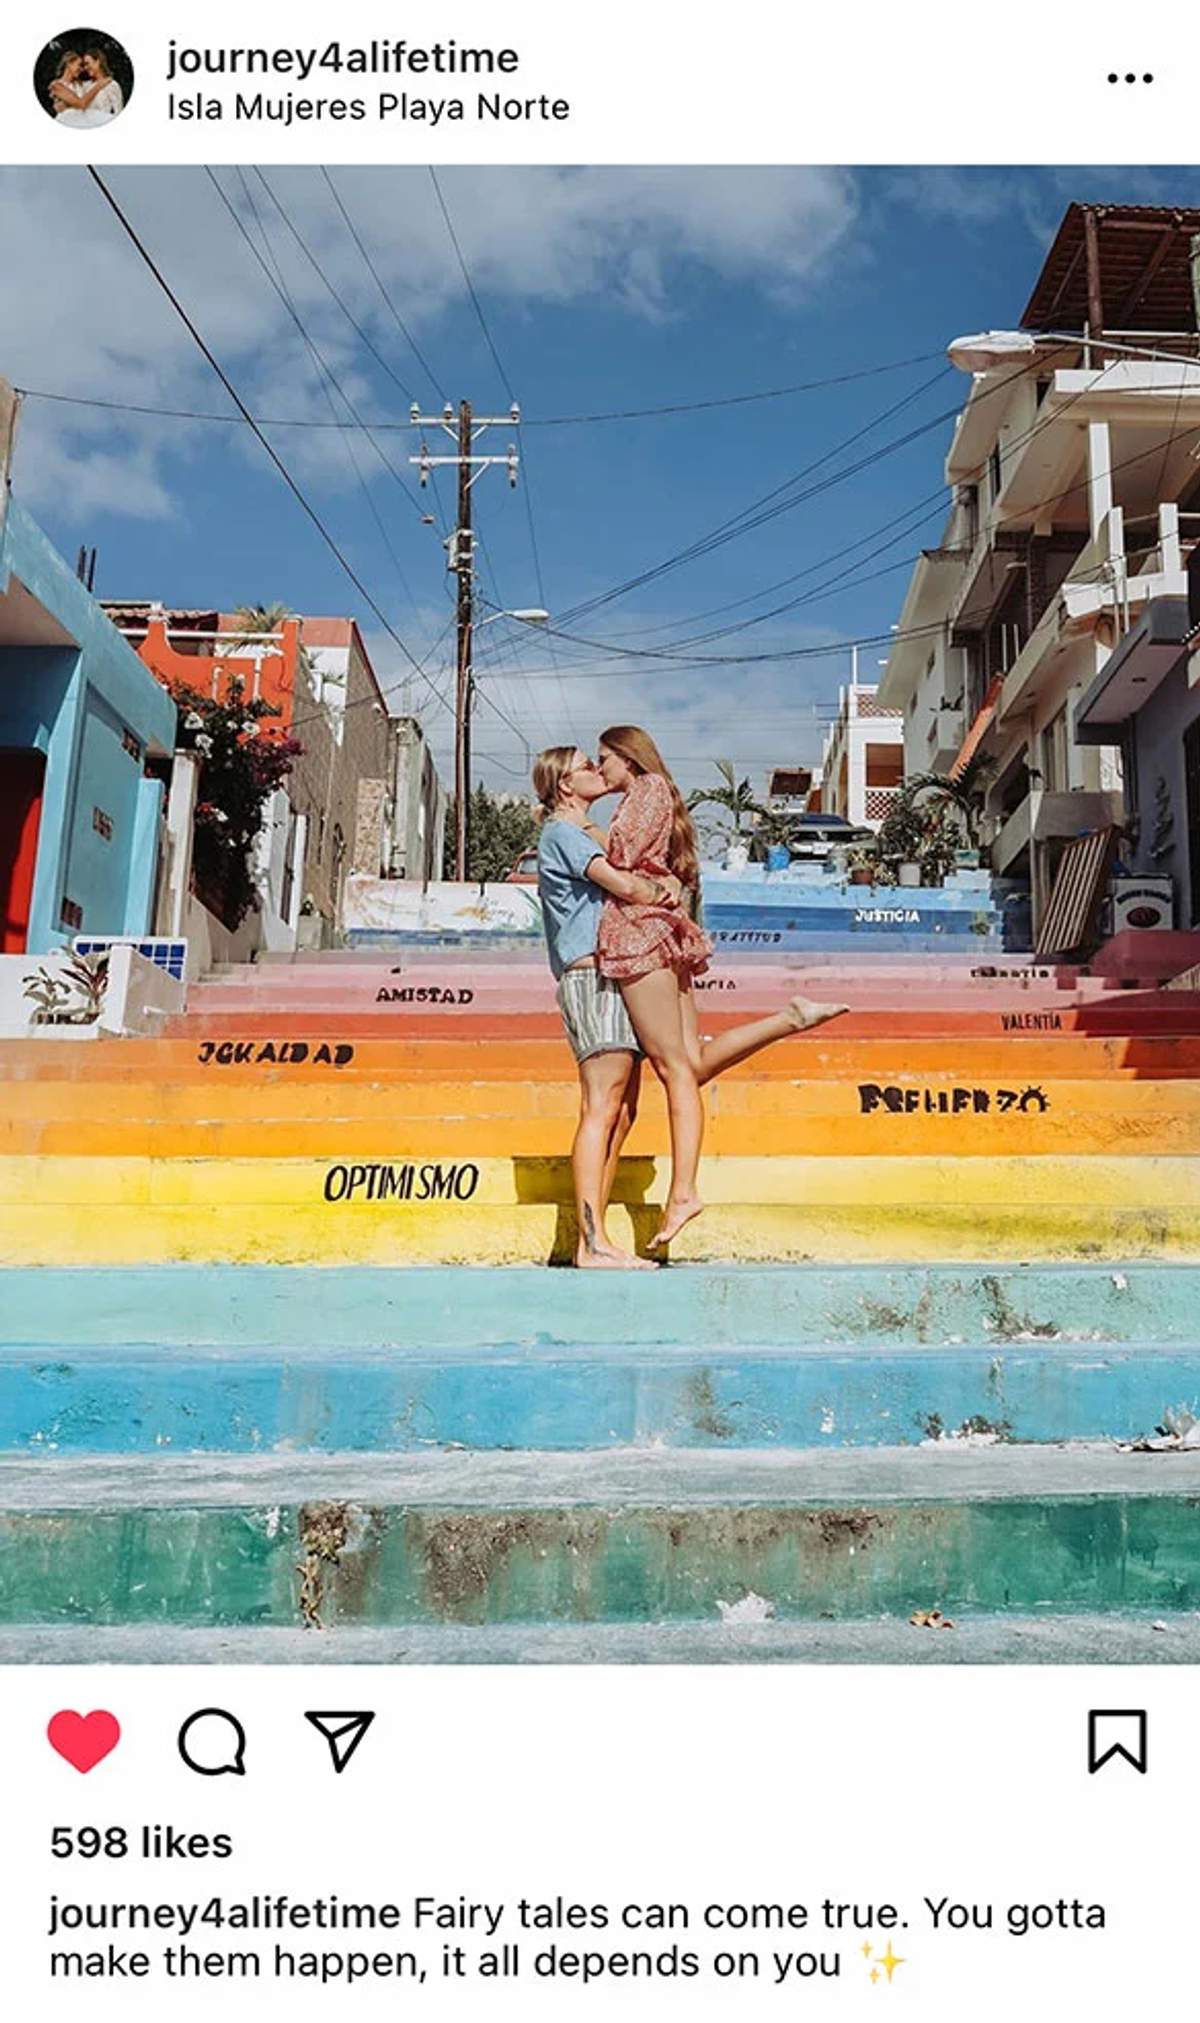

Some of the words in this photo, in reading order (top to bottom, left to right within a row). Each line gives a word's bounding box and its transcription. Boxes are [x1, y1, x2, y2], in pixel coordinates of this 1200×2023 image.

[855, 909, 920, 923] JUSTICIA
[376, 987, 473, 1004] AMISTAD
[323, 1164, 479, 1202] OPTIMISMO
